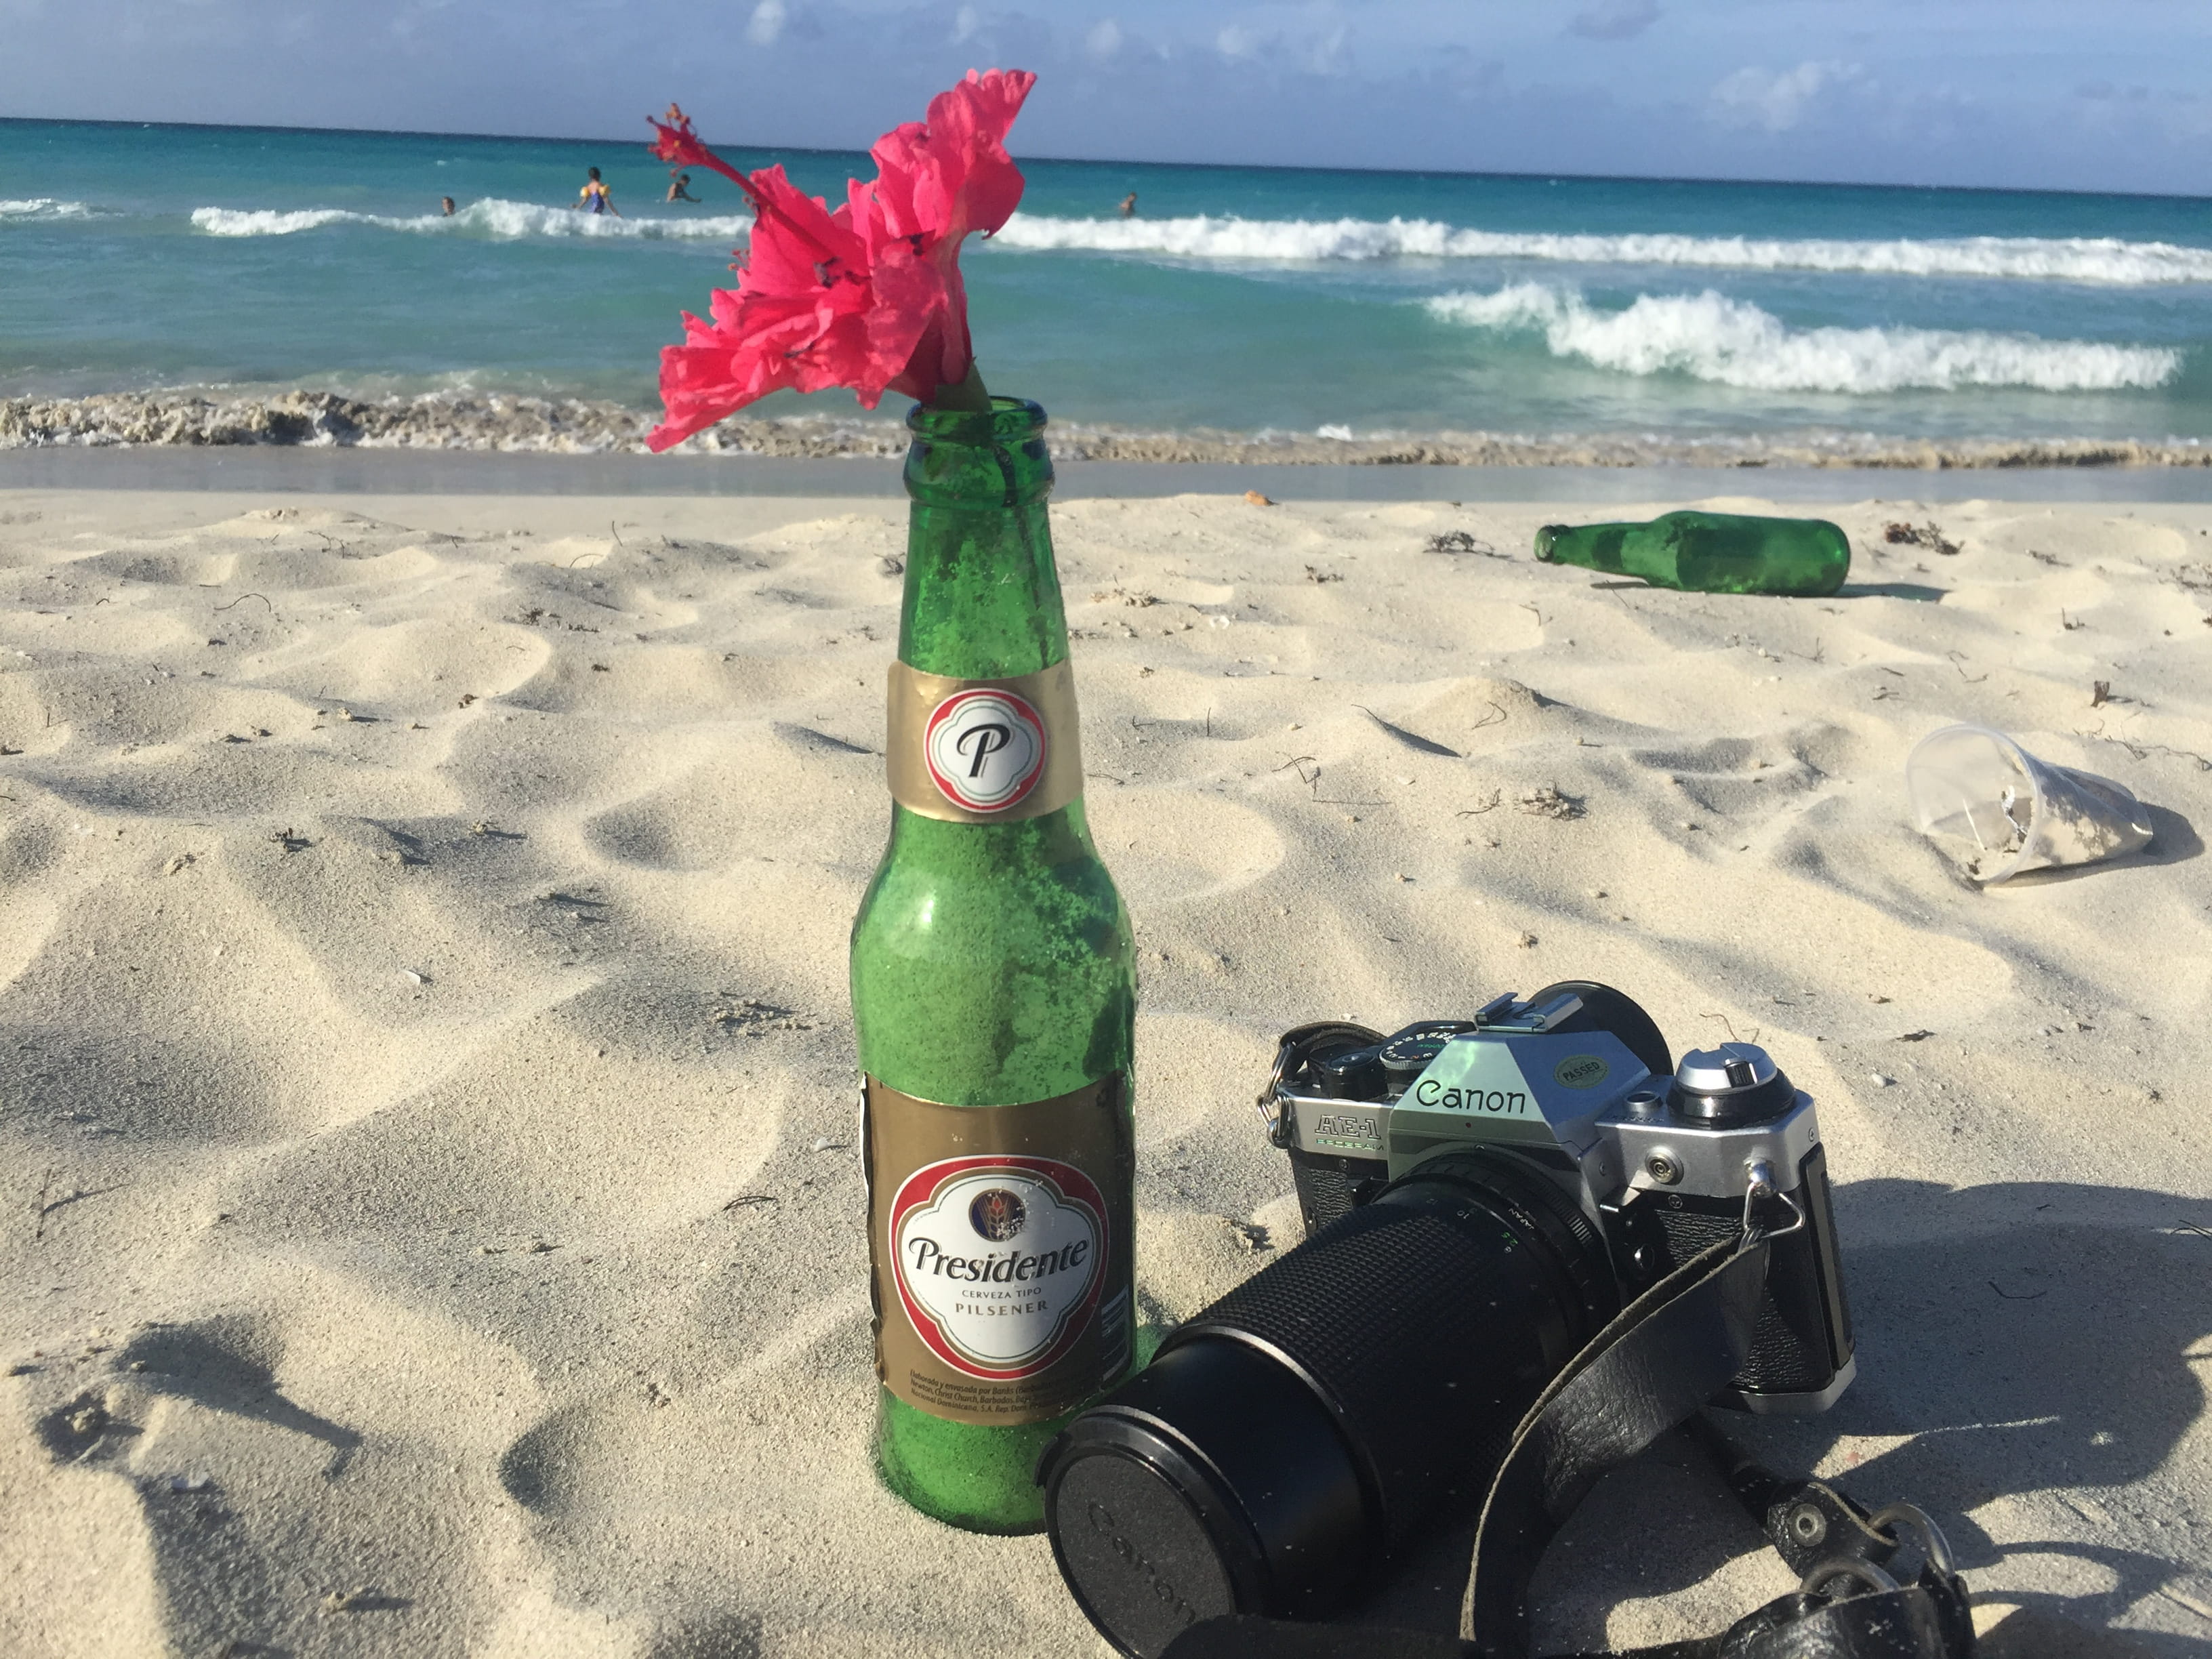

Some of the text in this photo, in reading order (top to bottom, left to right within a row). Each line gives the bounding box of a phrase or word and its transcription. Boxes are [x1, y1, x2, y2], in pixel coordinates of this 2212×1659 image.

[956, 723, 1013, 778] P
[1563, 1062, 1600, 1081] PASSED
[1416, 1080, 1525, 1113] Canon
[1315, 1115, 1381, 1140] AE-1
[909, 1237, 1089, 1283] Presidente
[962, 1287, 1042, 1299] CERVEZA TIPO
[956, 1300, 1048, 1316] PILSENER
[911, 1387, 936, 1404] Nacional
[935, 1388, 953, 1399] Christ
[954, 1393, 979, 1404] Church,
[945, 1383, 977, 1393] envasada
[992, 1387, 1014, 1395] Banks
[1088, 1502, 1197, 1623] Canon
